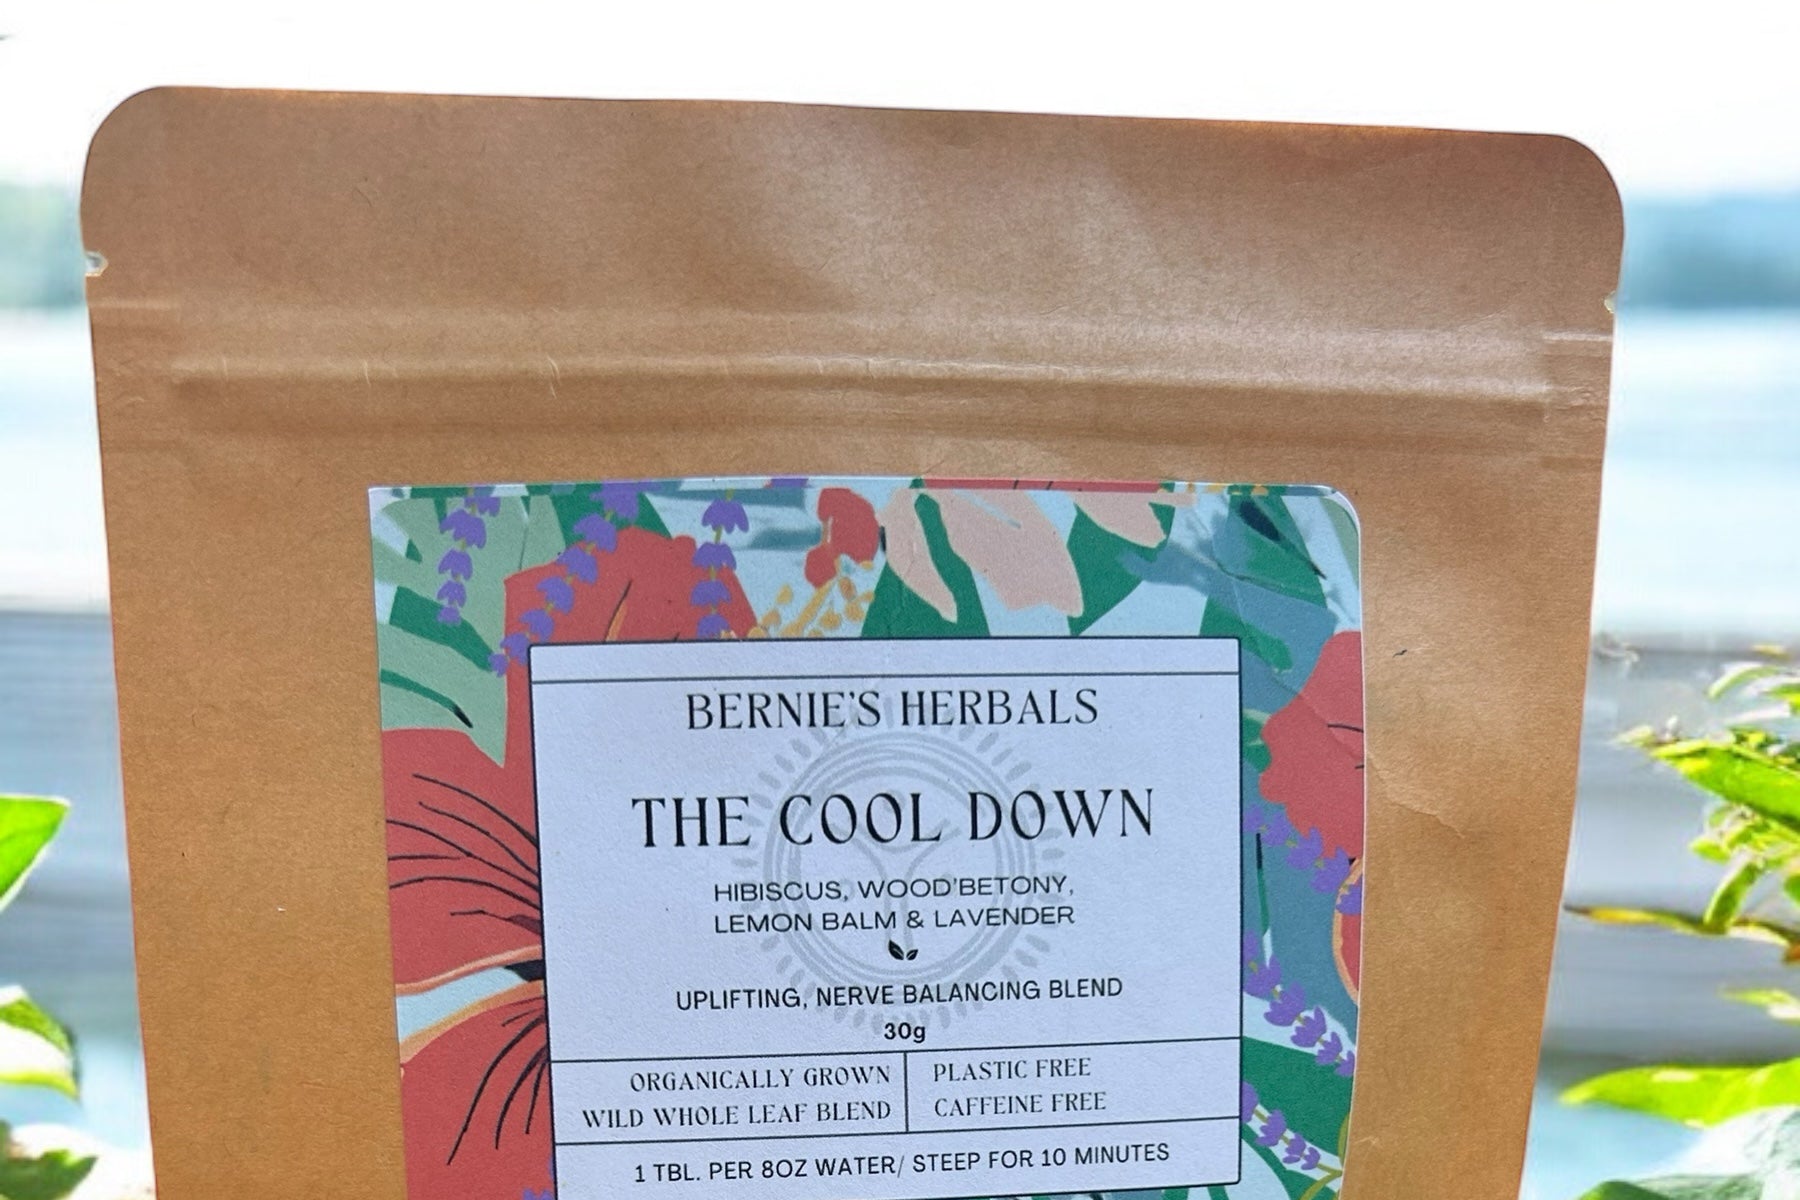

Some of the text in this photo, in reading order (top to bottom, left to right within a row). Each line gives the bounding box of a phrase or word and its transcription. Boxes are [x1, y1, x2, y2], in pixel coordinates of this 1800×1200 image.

[686, 688, 1098, 730] BERNIE'S HERBALS
[631, 788, 1153, 849] THE COOL DOWN
[714, 880, 849, 903] HIBISCUS,
[714, 905, 1076, 934] LEMON BALM & LAVENDER
[676, 977, 1123, 1011] UPLIFTING, NERVE BALANCING BLEND
[883, 1021, 926, 1044] 30g
[629, 1065, 890, 1093] ORGANICALLY GROWN
[933, 1057, 1091, 1083] PLASTIC FREE
[581, 1100, 891, 1129] WILD WHOLE LEAF BLEND
[934, 1091, 1107, 1118] CAFFEINE FREE
[634, 1164, 646, 1183] 1
[652, 1162, 701, 1182] TBL.
[709, 1160, 754, 1181] PER
[912, 1151, 981, 1173] STEEP
[988, 1149, 1035, 1169] FOR
[1041, 1147, 1067, 1167] 10
[1074, 1142, 1170, 1165] MINUTES
